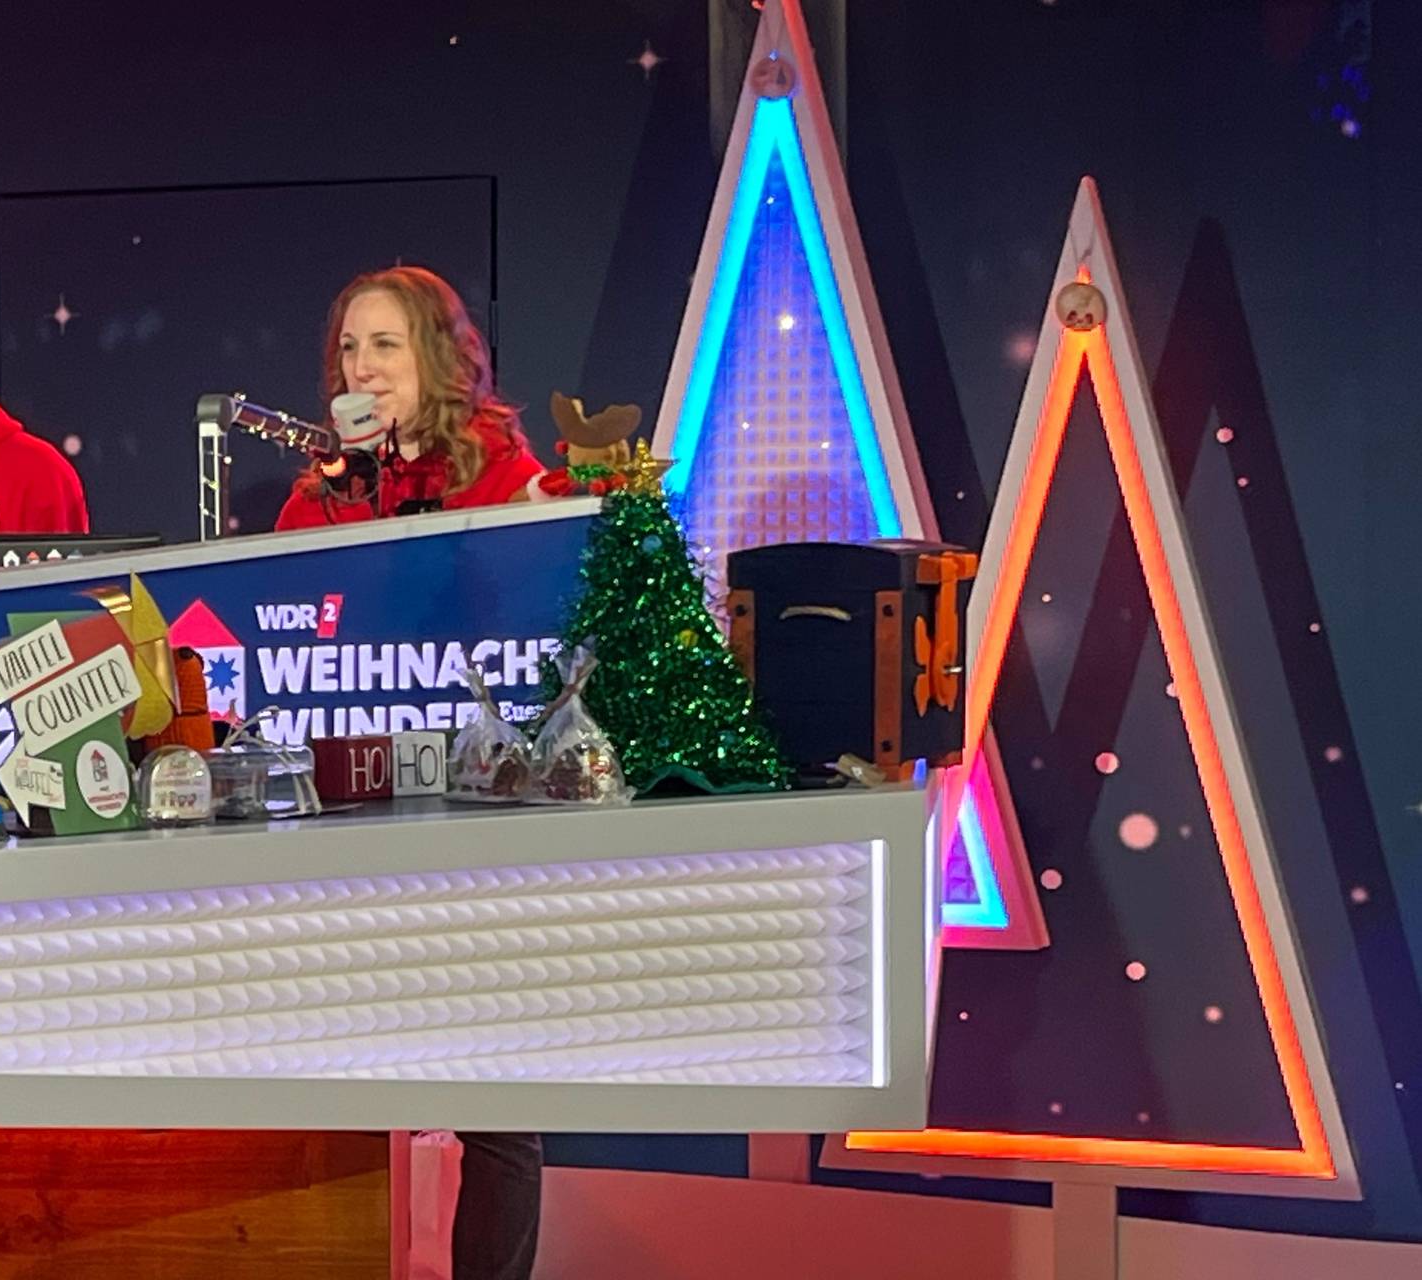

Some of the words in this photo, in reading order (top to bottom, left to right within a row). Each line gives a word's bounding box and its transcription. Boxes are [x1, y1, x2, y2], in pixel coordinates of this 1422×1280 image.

[255, 603, 318, 630] WDR
[323, 602, 337, 622] 2
[24, 658, 132, 737] COUNTER
[349, 746, 391, 793] HO!
[396, 744, 444, 788] HO!
